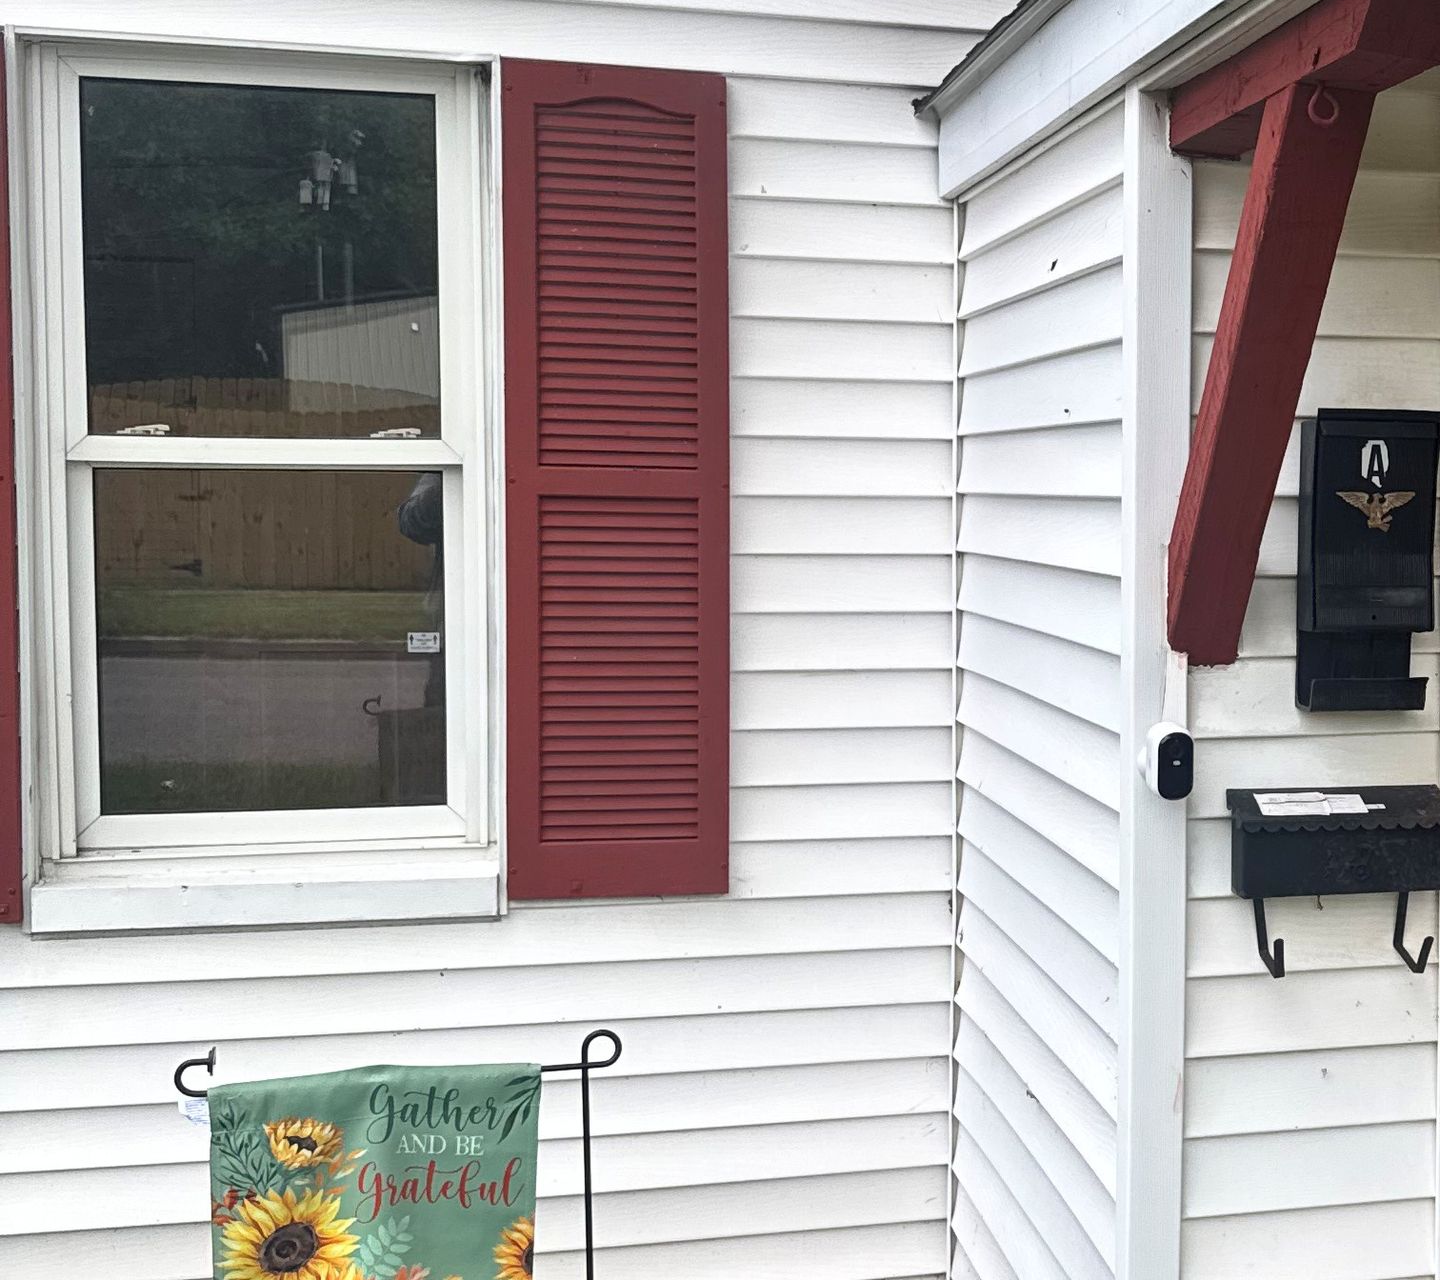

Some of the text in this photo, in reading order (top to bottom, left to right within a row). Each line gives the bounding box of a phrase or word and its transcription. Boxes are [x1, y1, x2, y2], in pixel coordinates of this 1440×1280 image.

[367, 1084, 505, 1144] Gather
[396, 1134, 484, 1156] AND BE
[355, 1157, 524, 1224] Grateful
